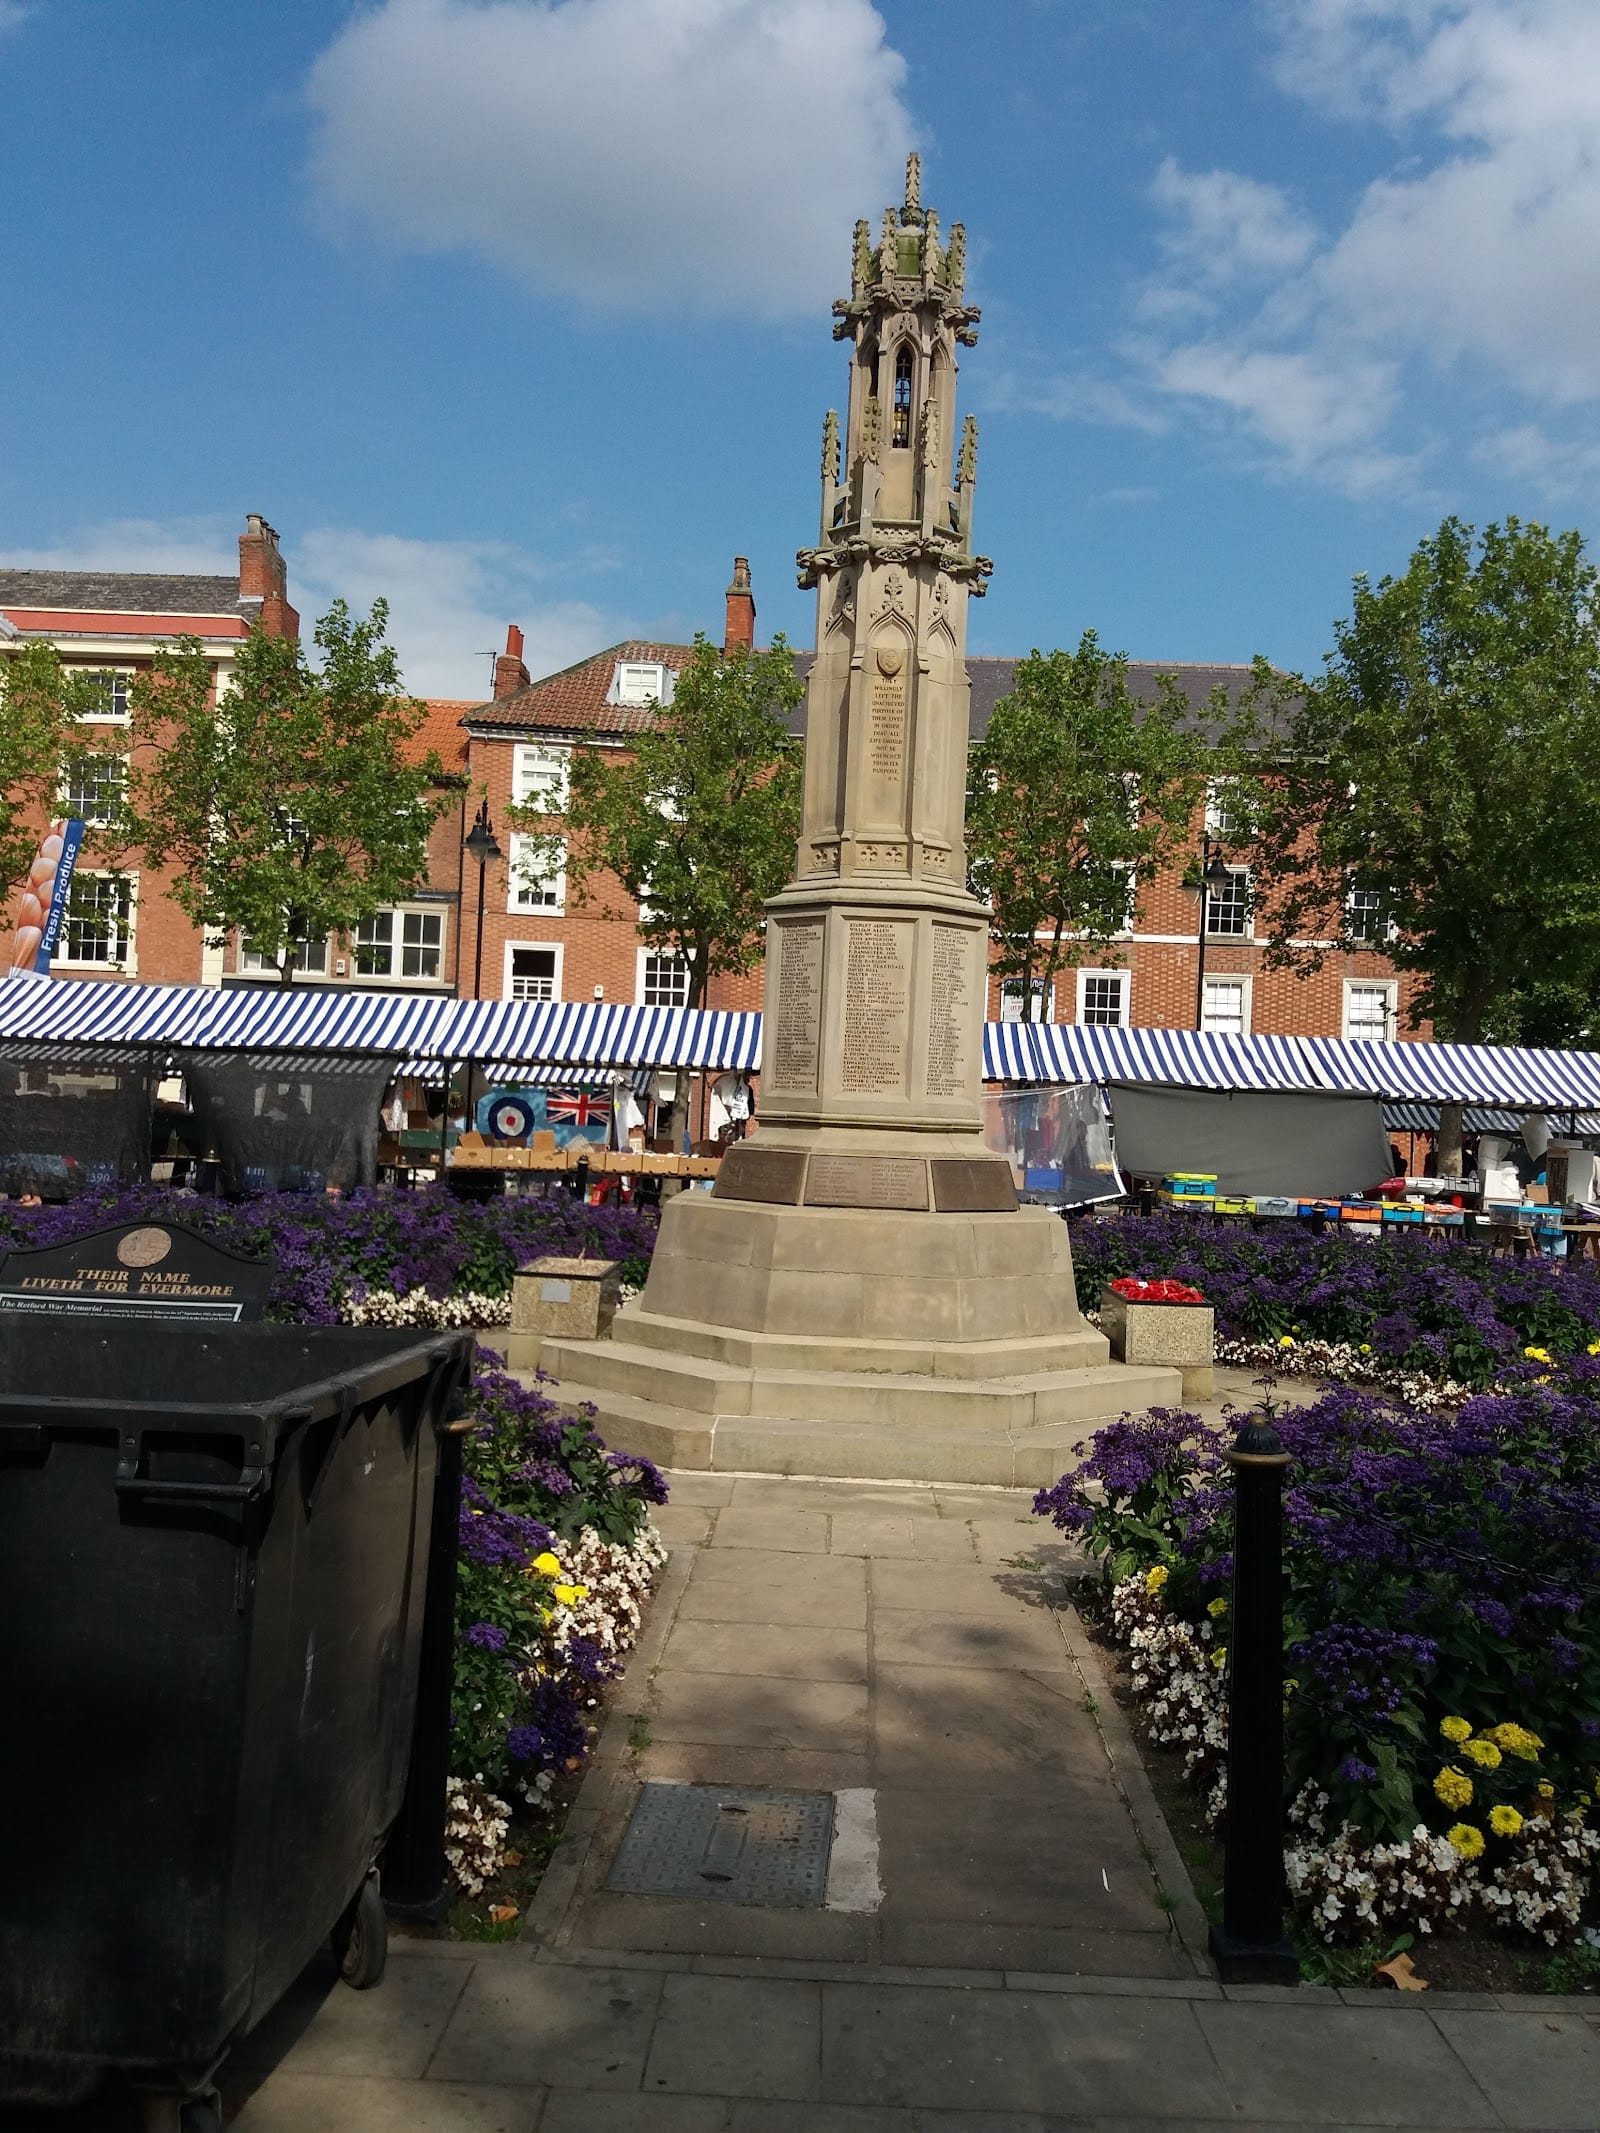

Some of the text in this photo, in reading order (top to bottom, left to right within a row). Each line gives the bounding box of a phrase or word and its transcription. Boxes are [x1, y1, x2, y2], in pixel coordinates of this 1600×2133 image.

[41, 844, 76, 950] Fresh Produce
[77, 1268, 190, 1284] THEIR NAME
[21, 1277, 234, 1296] LIVETH FOR EVERMORE
[17, 1301, 46, 1310] Retford
[66, 1304, 102, 1312] Memorial
